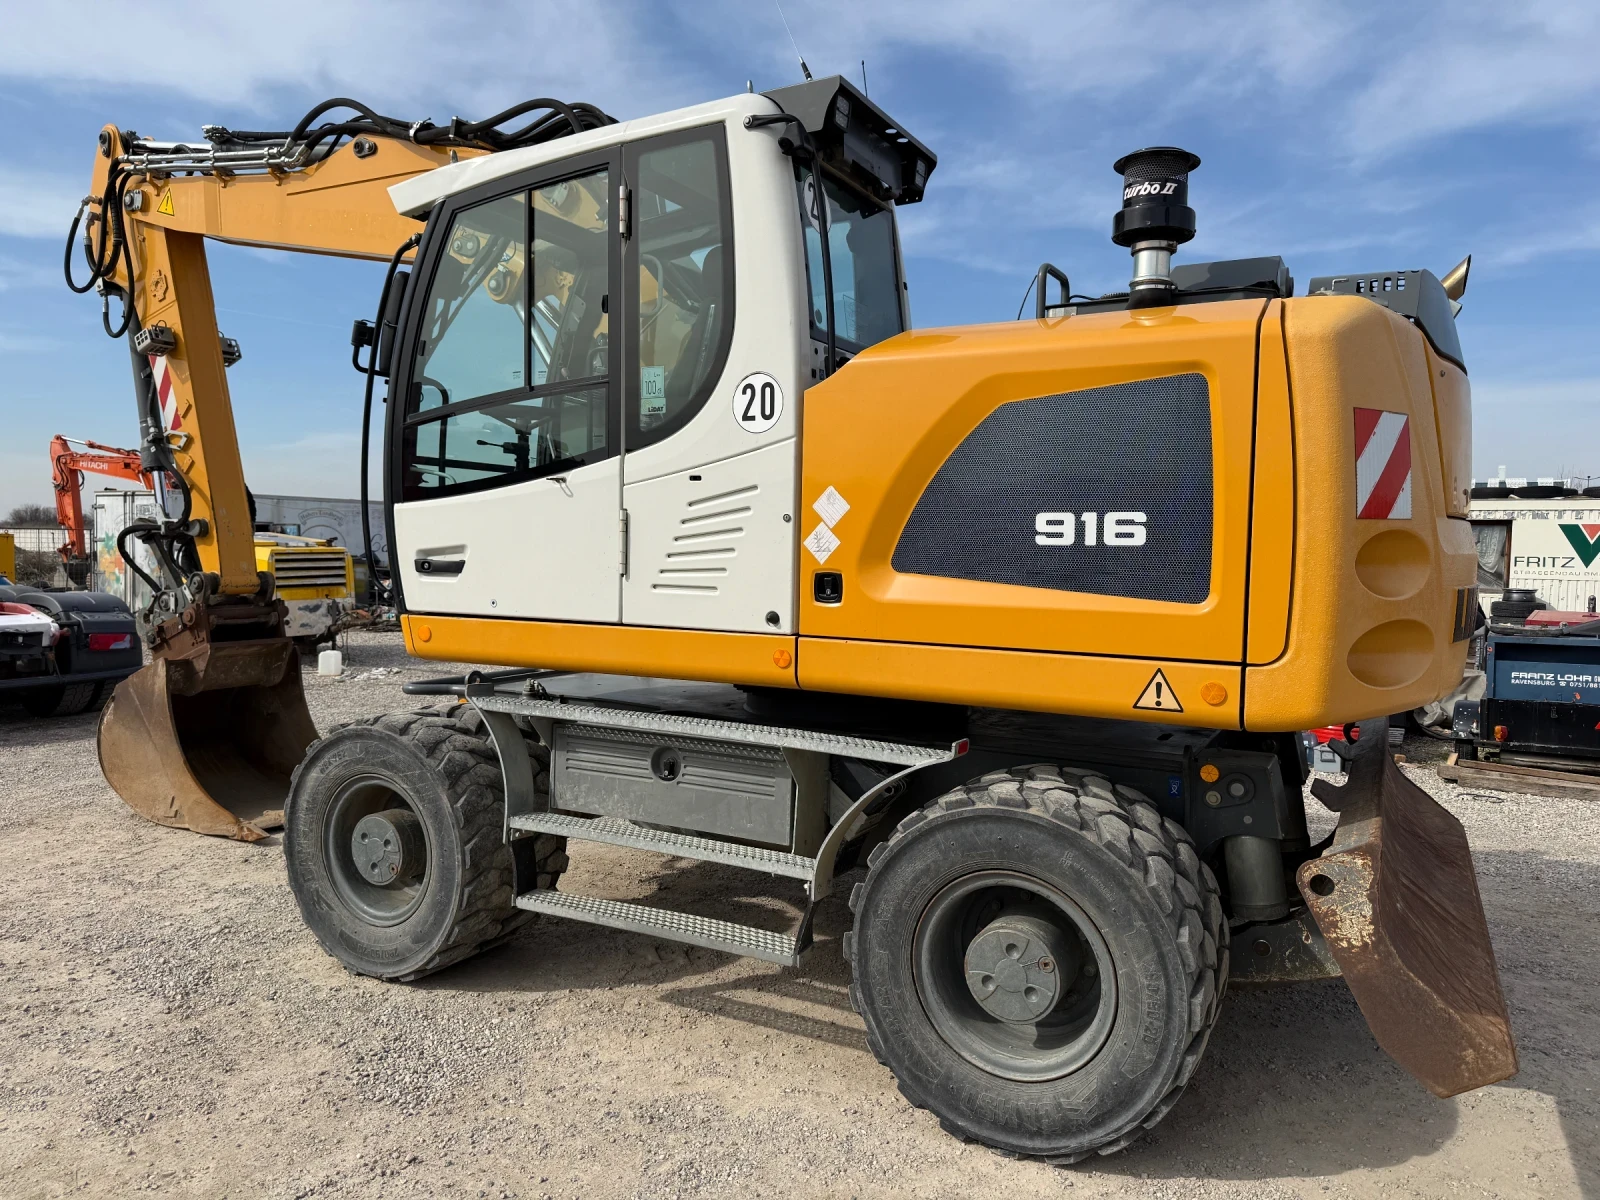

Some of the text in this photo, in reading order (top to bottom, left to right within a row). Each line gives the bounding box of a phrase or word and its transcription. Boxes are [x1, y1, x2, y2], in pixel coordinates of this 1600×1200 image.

[1124, 181, 1178, 200] turbo II
[644, 379, 657, 395] 100
[742, 381, 775, 421] 20
[79, 461, 109, 470] HITACHI
[1035, 511, 1147, 546] 916
[1514, 556, 1575, 568] FRITZ
[1511, 672, 1555, 680] FRANZ
[1557, 674, 1592, 682] LOHR
